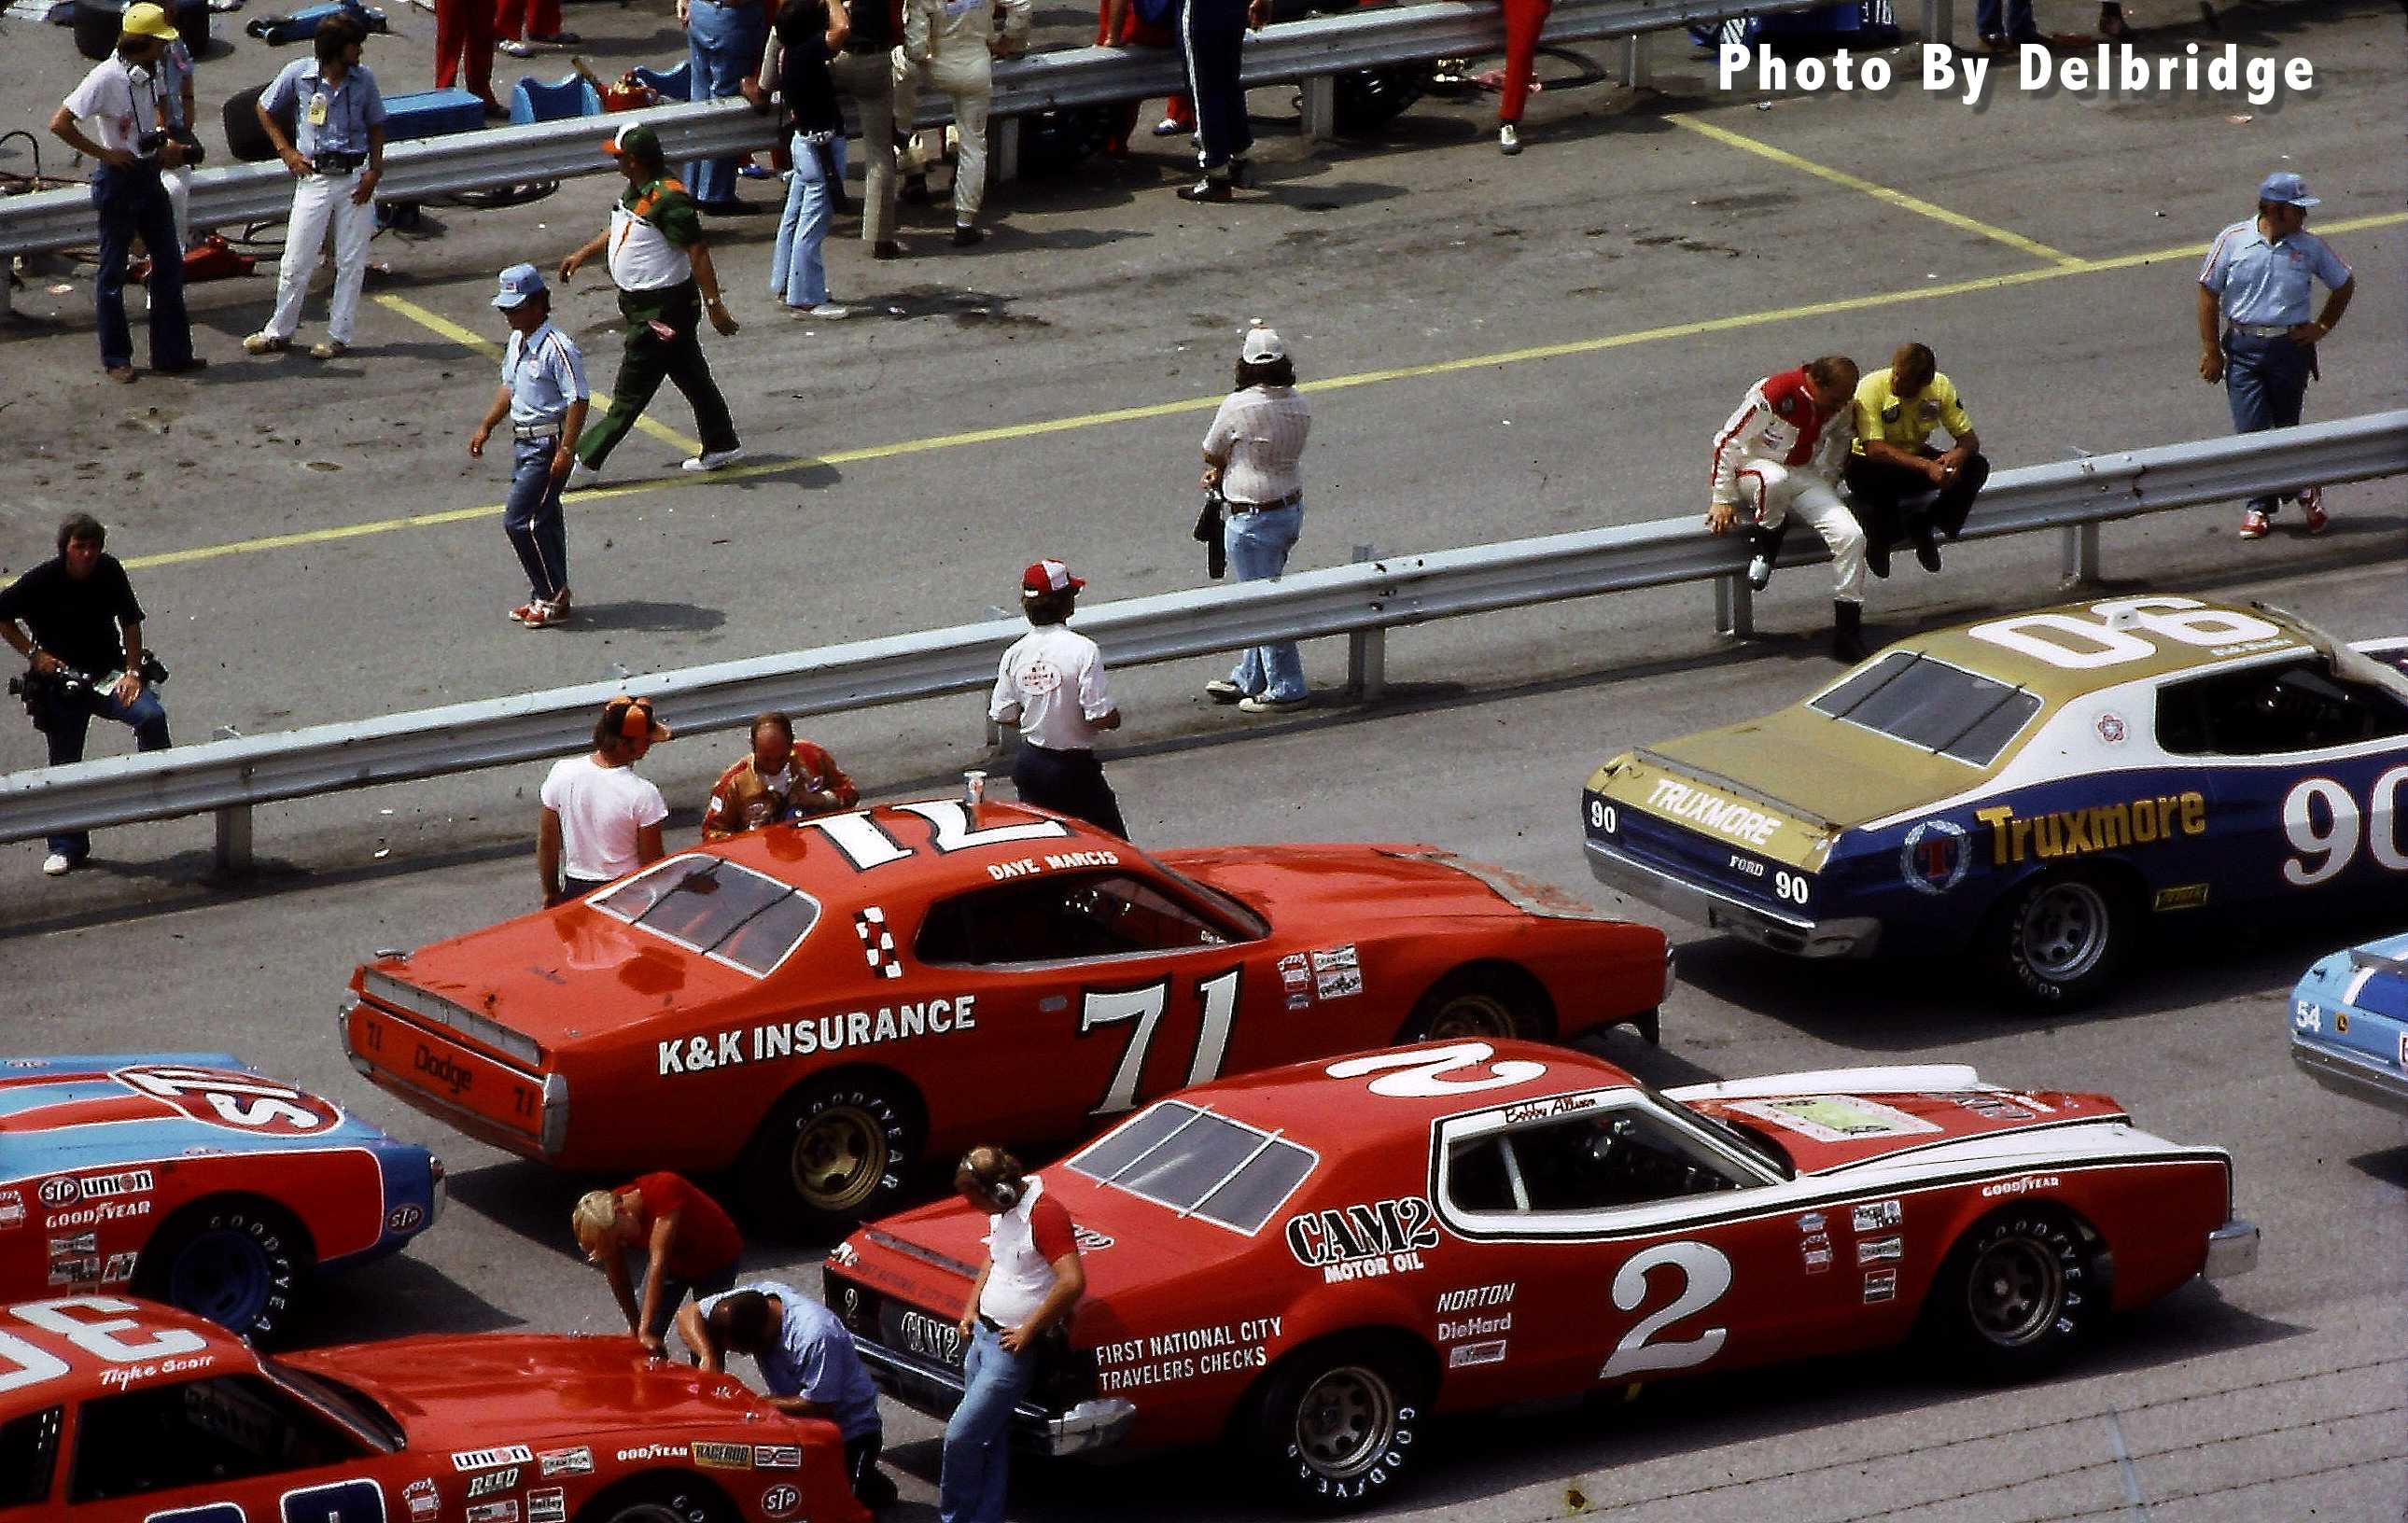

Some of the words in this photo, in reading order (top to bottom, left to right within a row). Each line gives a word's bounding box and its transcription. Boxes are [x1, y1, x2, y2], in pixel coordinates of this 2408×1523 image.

[1590, 801, 1617, 833] 90
[1646, 778, 1782, 845] TRUXMORE
[1974, 790, 2206, 866] Truxmore
[987, 859, 1041, 881] DAVE
[1044, 850, 1120, 870] MARCIS
[1729, 854, 1764, 877] FORD
[1775, 872, 1809, 904] 90
[2297, 1000, 2321, 1032] 54
[657, 1028, 744, 1076] K&K
[753, 994, 976, 1062] INSURANCE
[1079, 966, 1242, 1117] 71
[415, 1044, 473, 1094] Dodge
[515, 1085, 537, 1117] 71
[1505, 1102, 1548, 1124] Bobby
[44, 1180, 76, 1202] STP
[1981, 1177, 2060, 1196] GOODYEAR
[47, 1201, 150, 1228] GOODYEAR
[1286, 1195, 1440, 1267] CAM2
[1323, 1260, 1389, 1284] MOTOR
[1392, 1253, 1425, 1274] OIL
[1436, 1282, 1516, 1313] NORTON
[1599, 1240, 1733, 1378] 2
[1096, 1338, 1144, 1366] FIRST
[1149, 1325, 1236, 1357] NATIONAL
[1239, 1316, 1281, 1342] CITY
[1438, 1312, 1512, 1342] DieHard
[1099, 1358, 1195, 1391] TRAVELERS
[1199, 1346, 1267, 1375] CHECKS
[616, 1445, 688, 1461] GOODYEAR
[766, 1488, 796, 1510] STP
